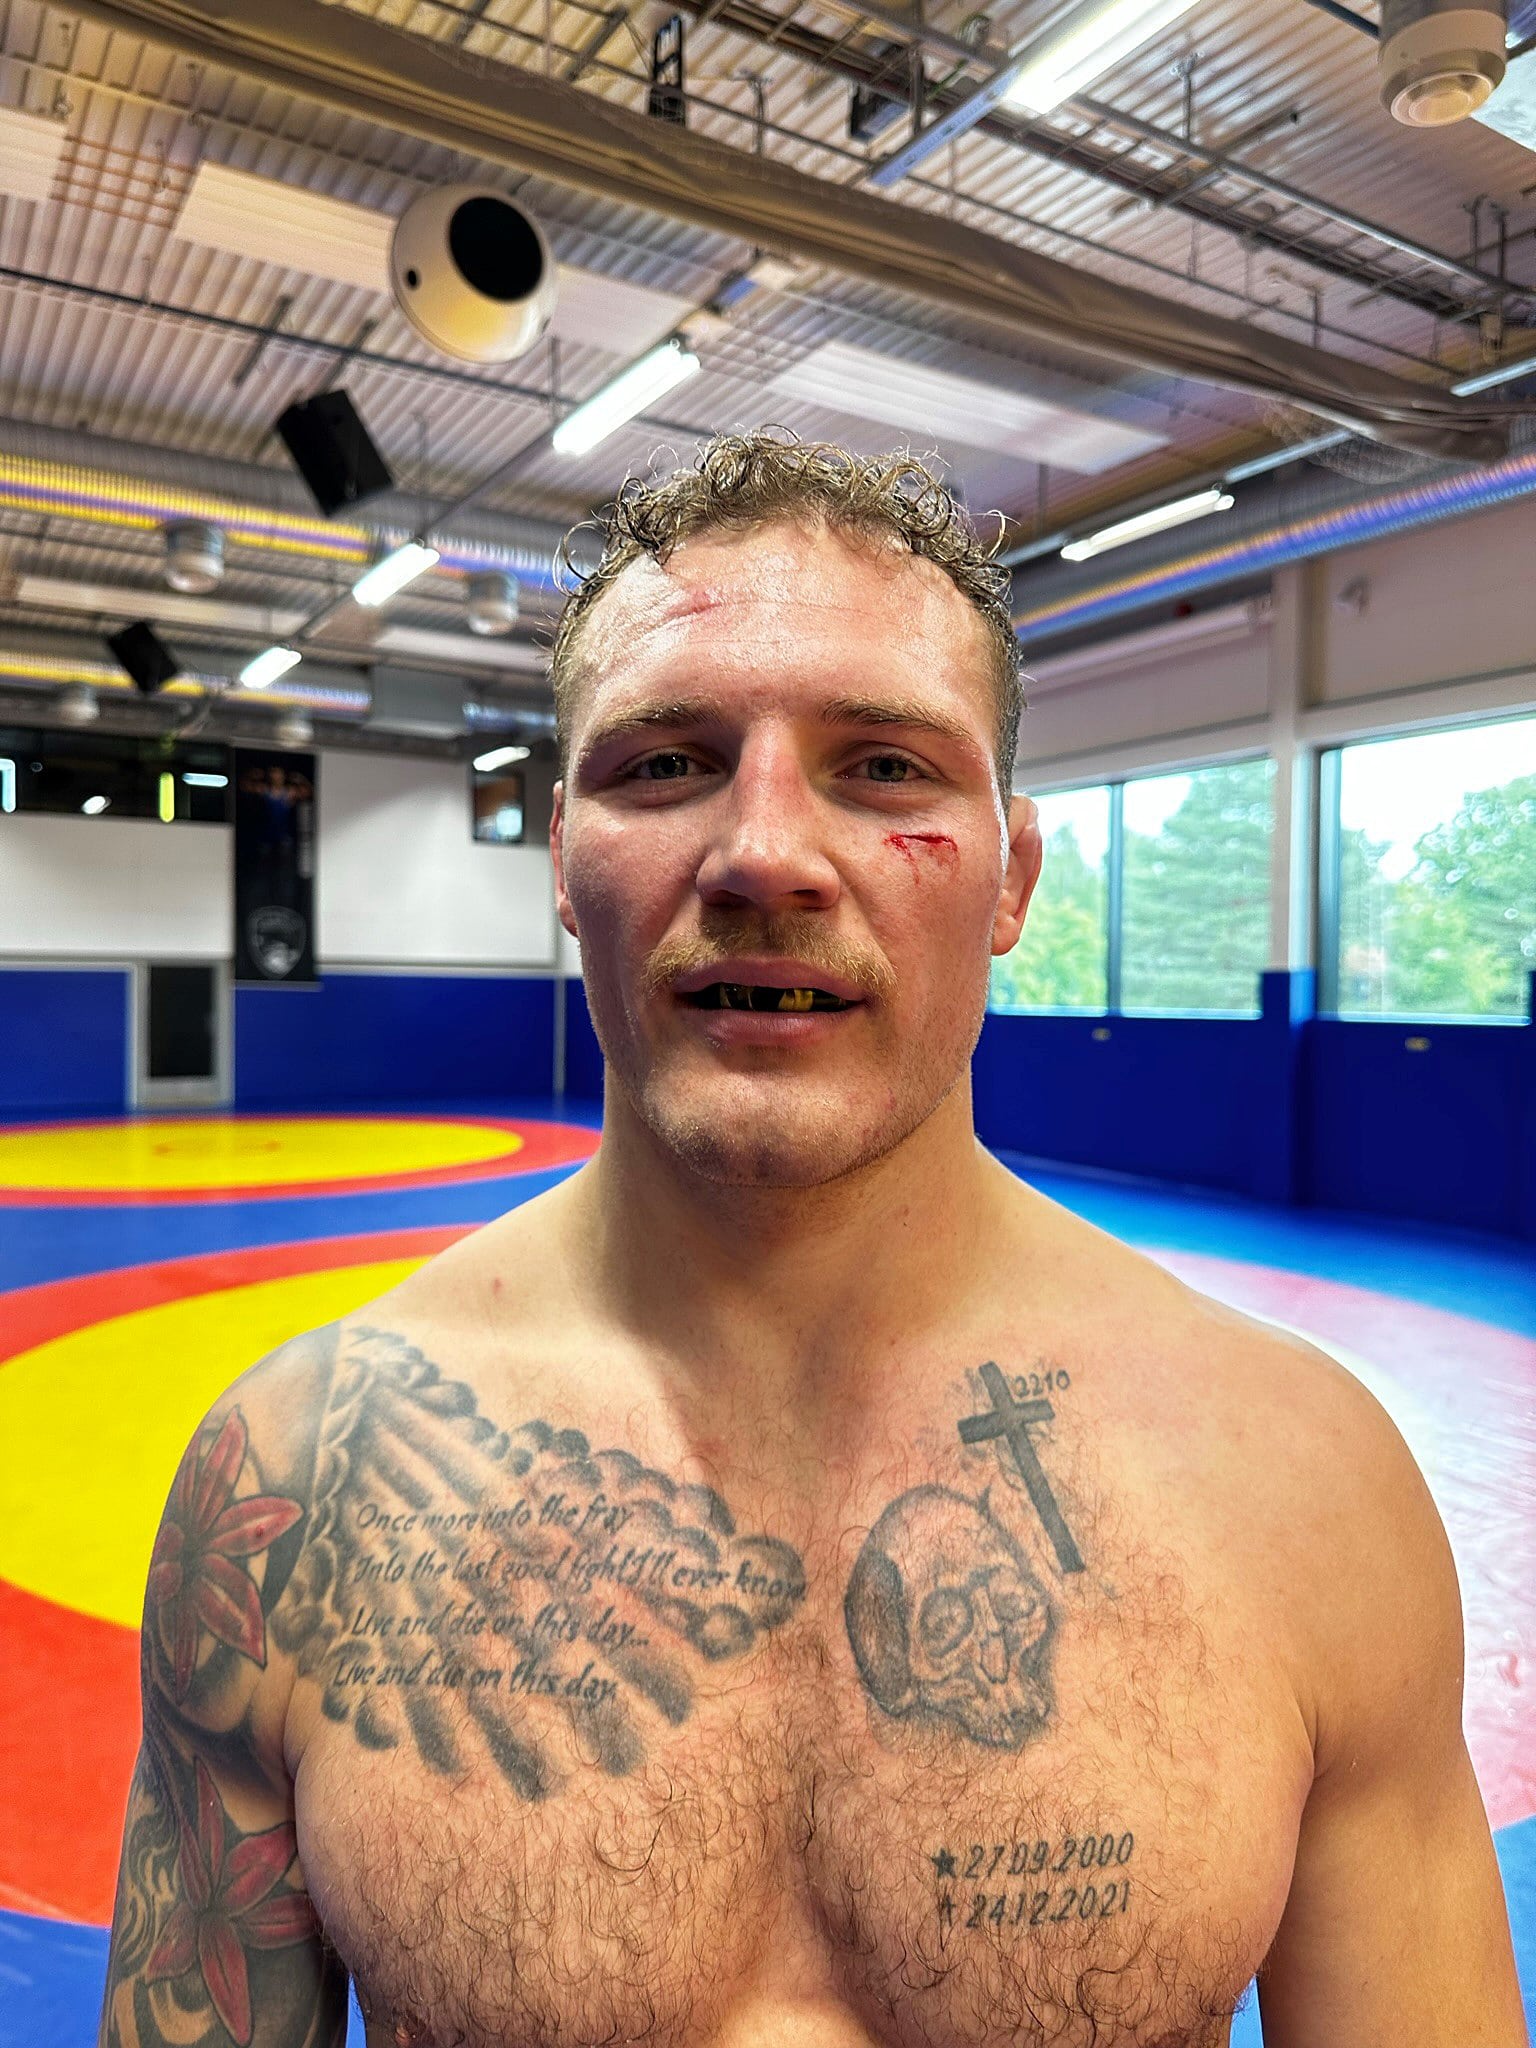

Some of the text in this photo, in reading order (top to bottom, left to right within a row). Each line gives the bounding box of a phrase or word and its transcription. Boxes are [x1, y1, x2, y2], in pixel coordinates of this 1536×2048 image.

[1013, 1368, 1071, 1399] 2210
[357, 1503, 418, 1532] Once
[422, 1513, 480, 1531] more
[539, 1493, 578, 1527] the
[410, 1549, 448, 1583] the
[672, 1567, 730, 1588] ever
[351, 1607, 396, 1637] Live
[397, 1601, 455, 1636] and
[333, 1656, 376, 1687] Live
[376, 1648, 435, 1685] and
